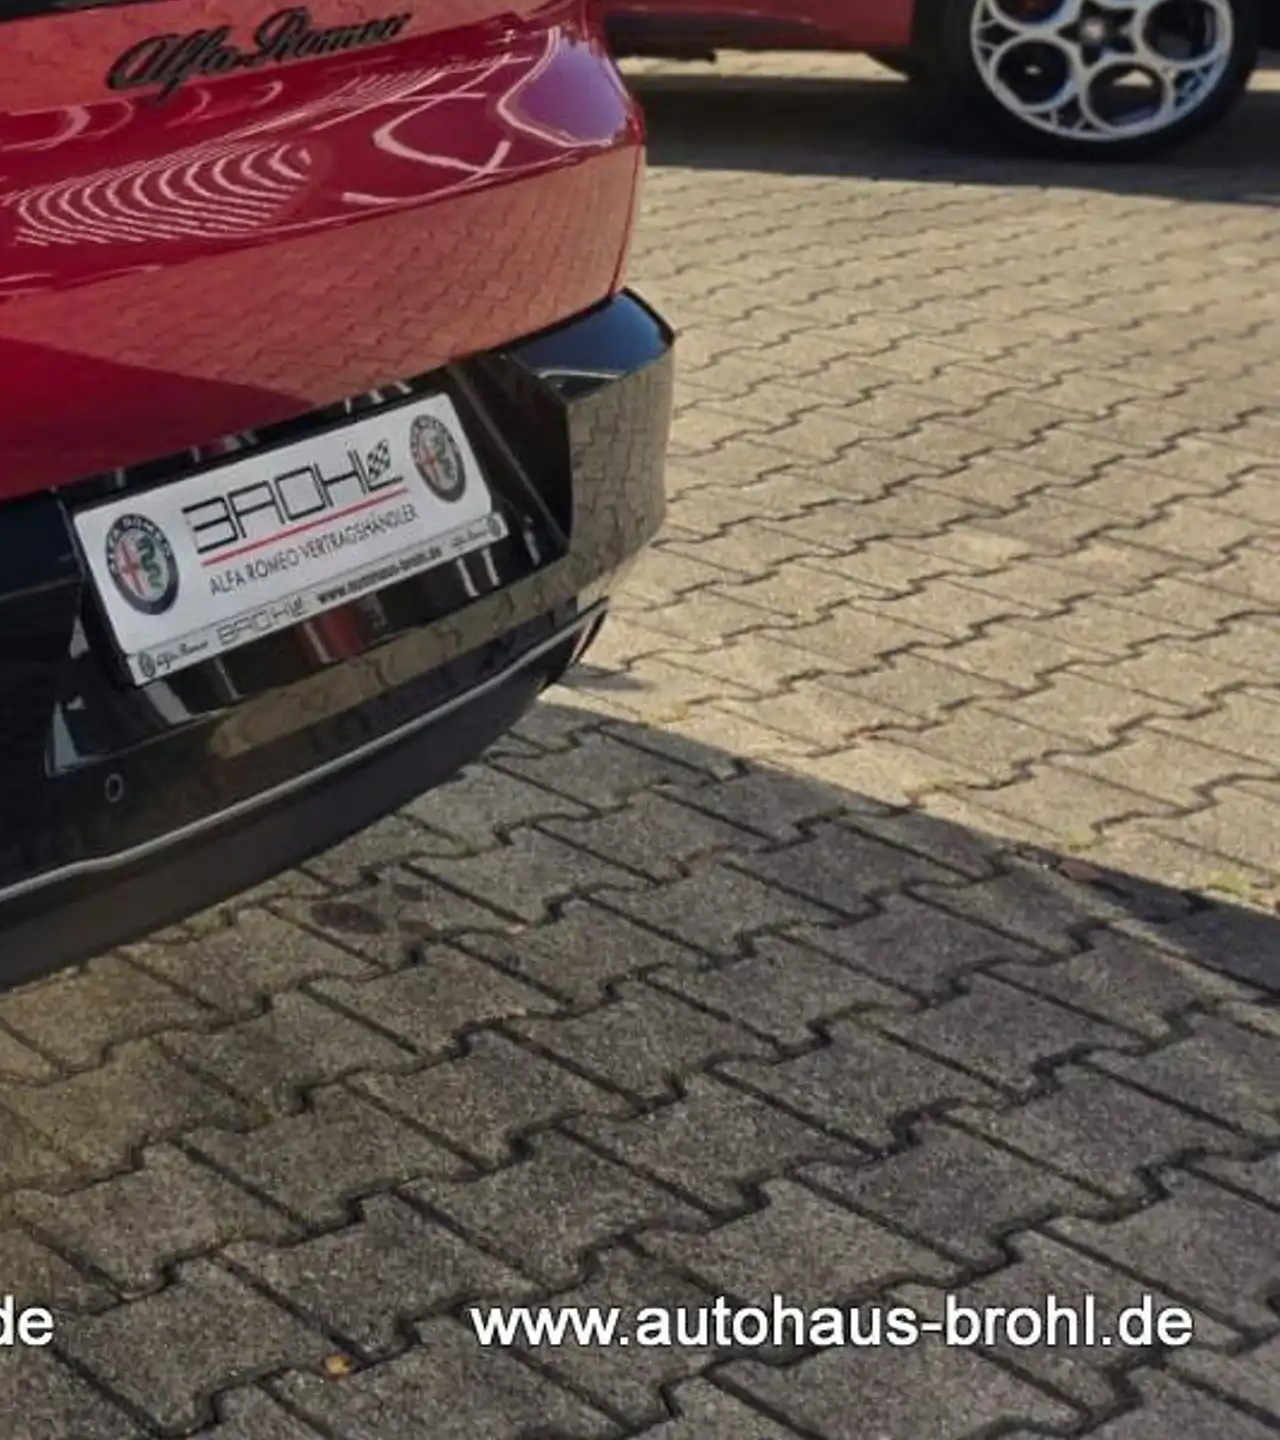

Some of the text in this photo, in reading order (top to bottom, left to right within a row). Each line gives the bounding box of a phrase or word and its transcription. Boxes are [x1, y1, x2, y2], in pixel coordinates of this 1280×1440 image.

[106, 6, 413, 104] Alfa Romeo
[208, 570, 246, 597] ALFA
[247, 547, 300, 580] ROMEO
